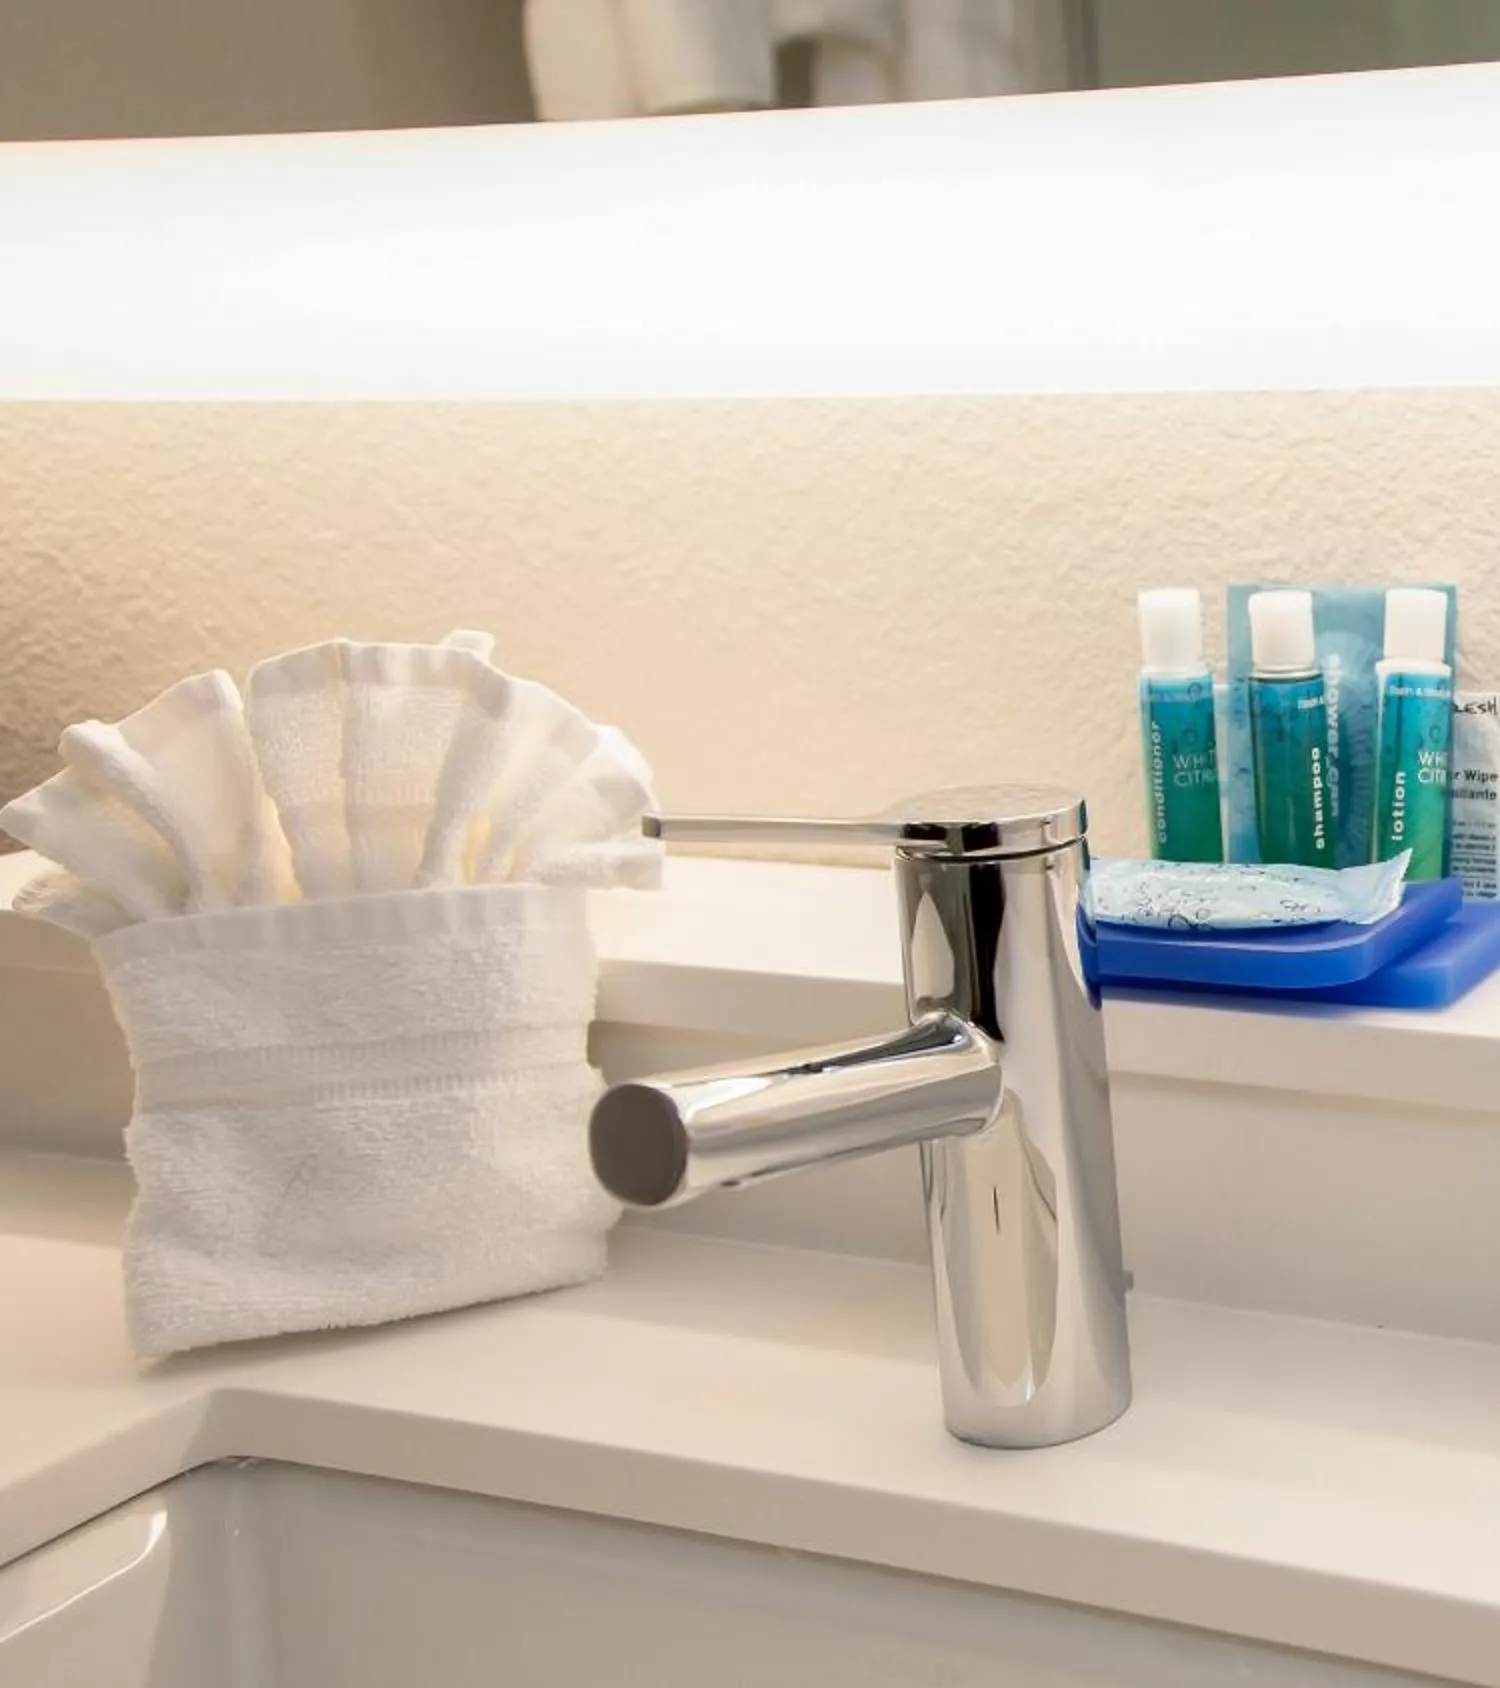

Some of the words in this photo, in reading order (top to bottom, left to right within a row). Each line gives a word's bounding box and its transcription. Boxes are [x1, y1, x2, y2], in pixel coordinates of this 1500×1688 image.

[1151, 721, 1167, 843] conditioner
[1311, 747, 1325, 850] shampoo
[1391, 771, 1407, 841] lotion
[1463, 769, 1499, 784] Wipe
